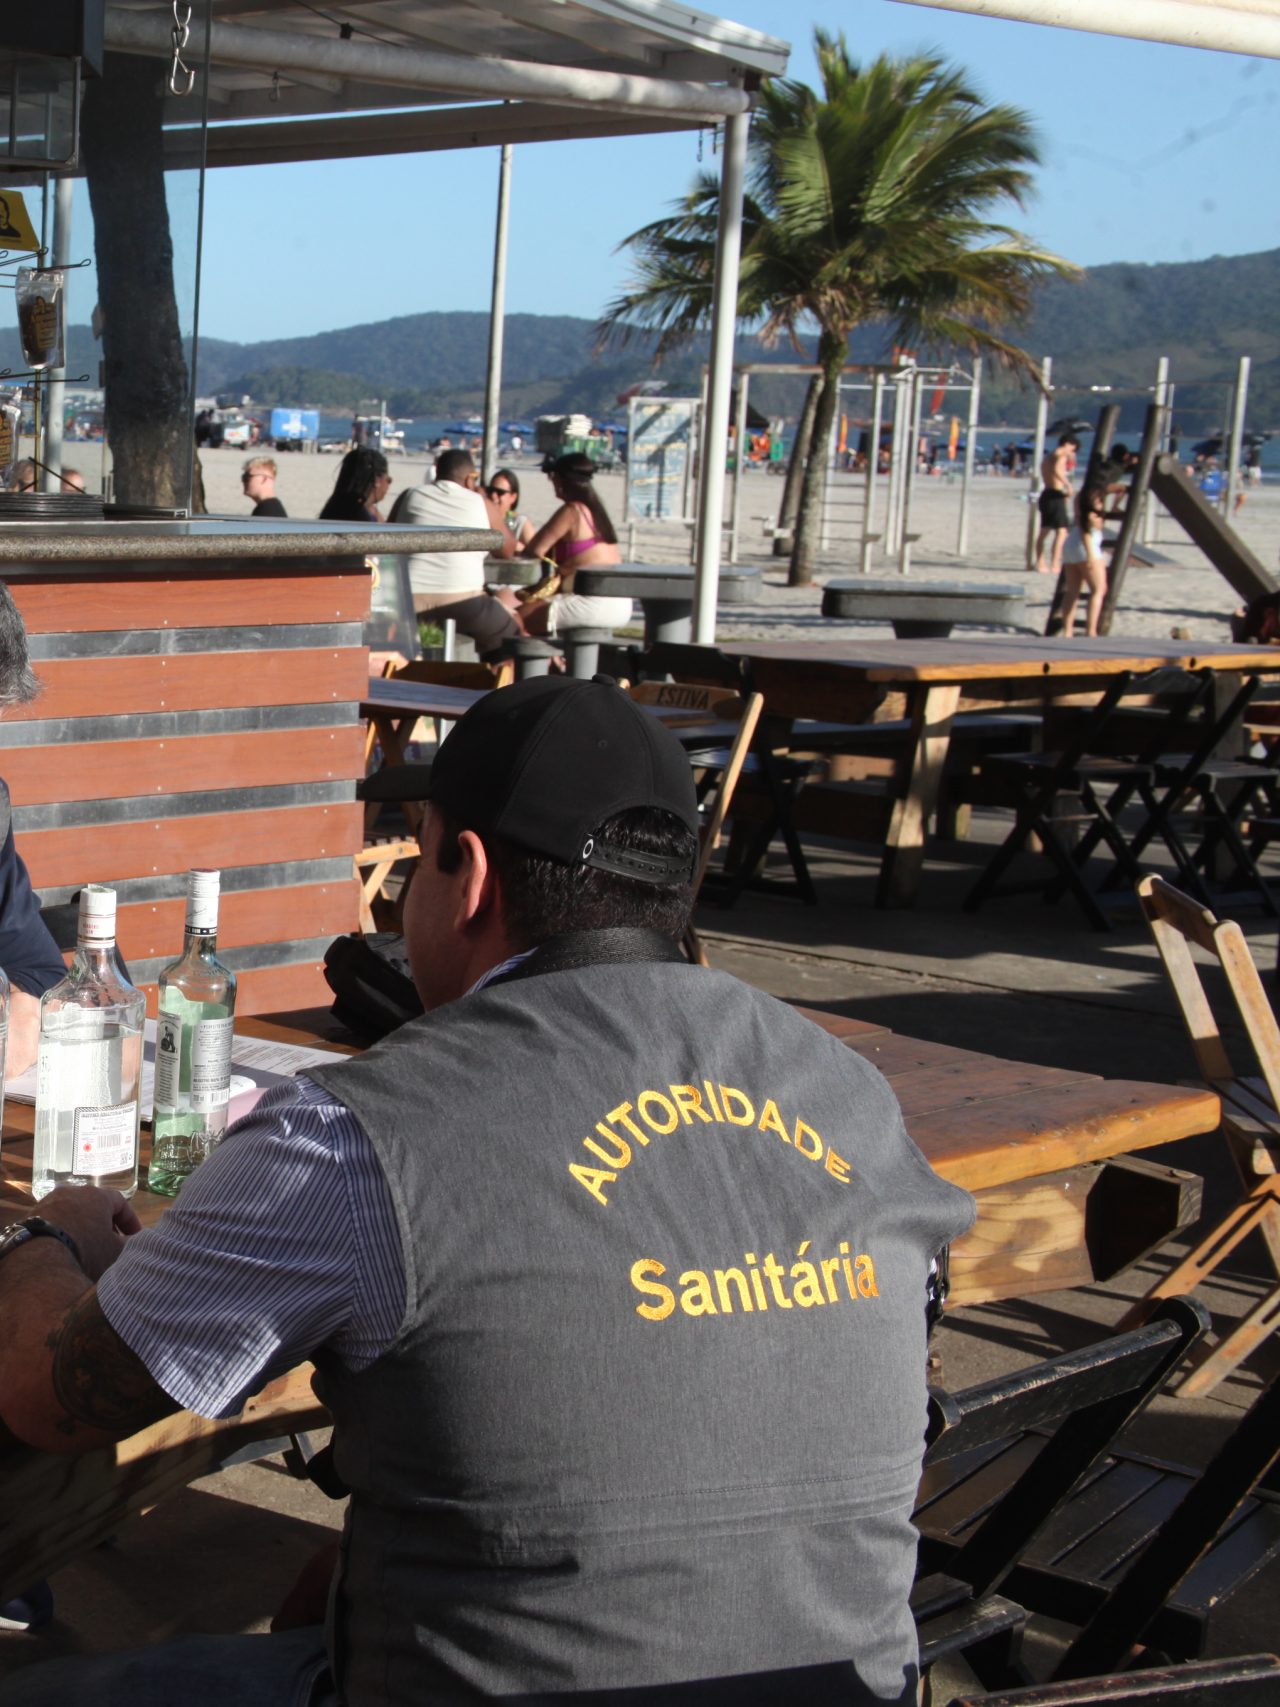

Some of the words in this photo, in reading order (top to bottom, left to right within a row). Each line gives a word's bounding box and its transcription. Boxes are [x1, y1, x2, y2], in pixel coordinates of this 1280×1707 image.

[656, 685, 710, 709] ESTIVA
[568, 1079, 853, 1207] AUTORIDADE
[629, 1240, 880, 1322] Sanitária
